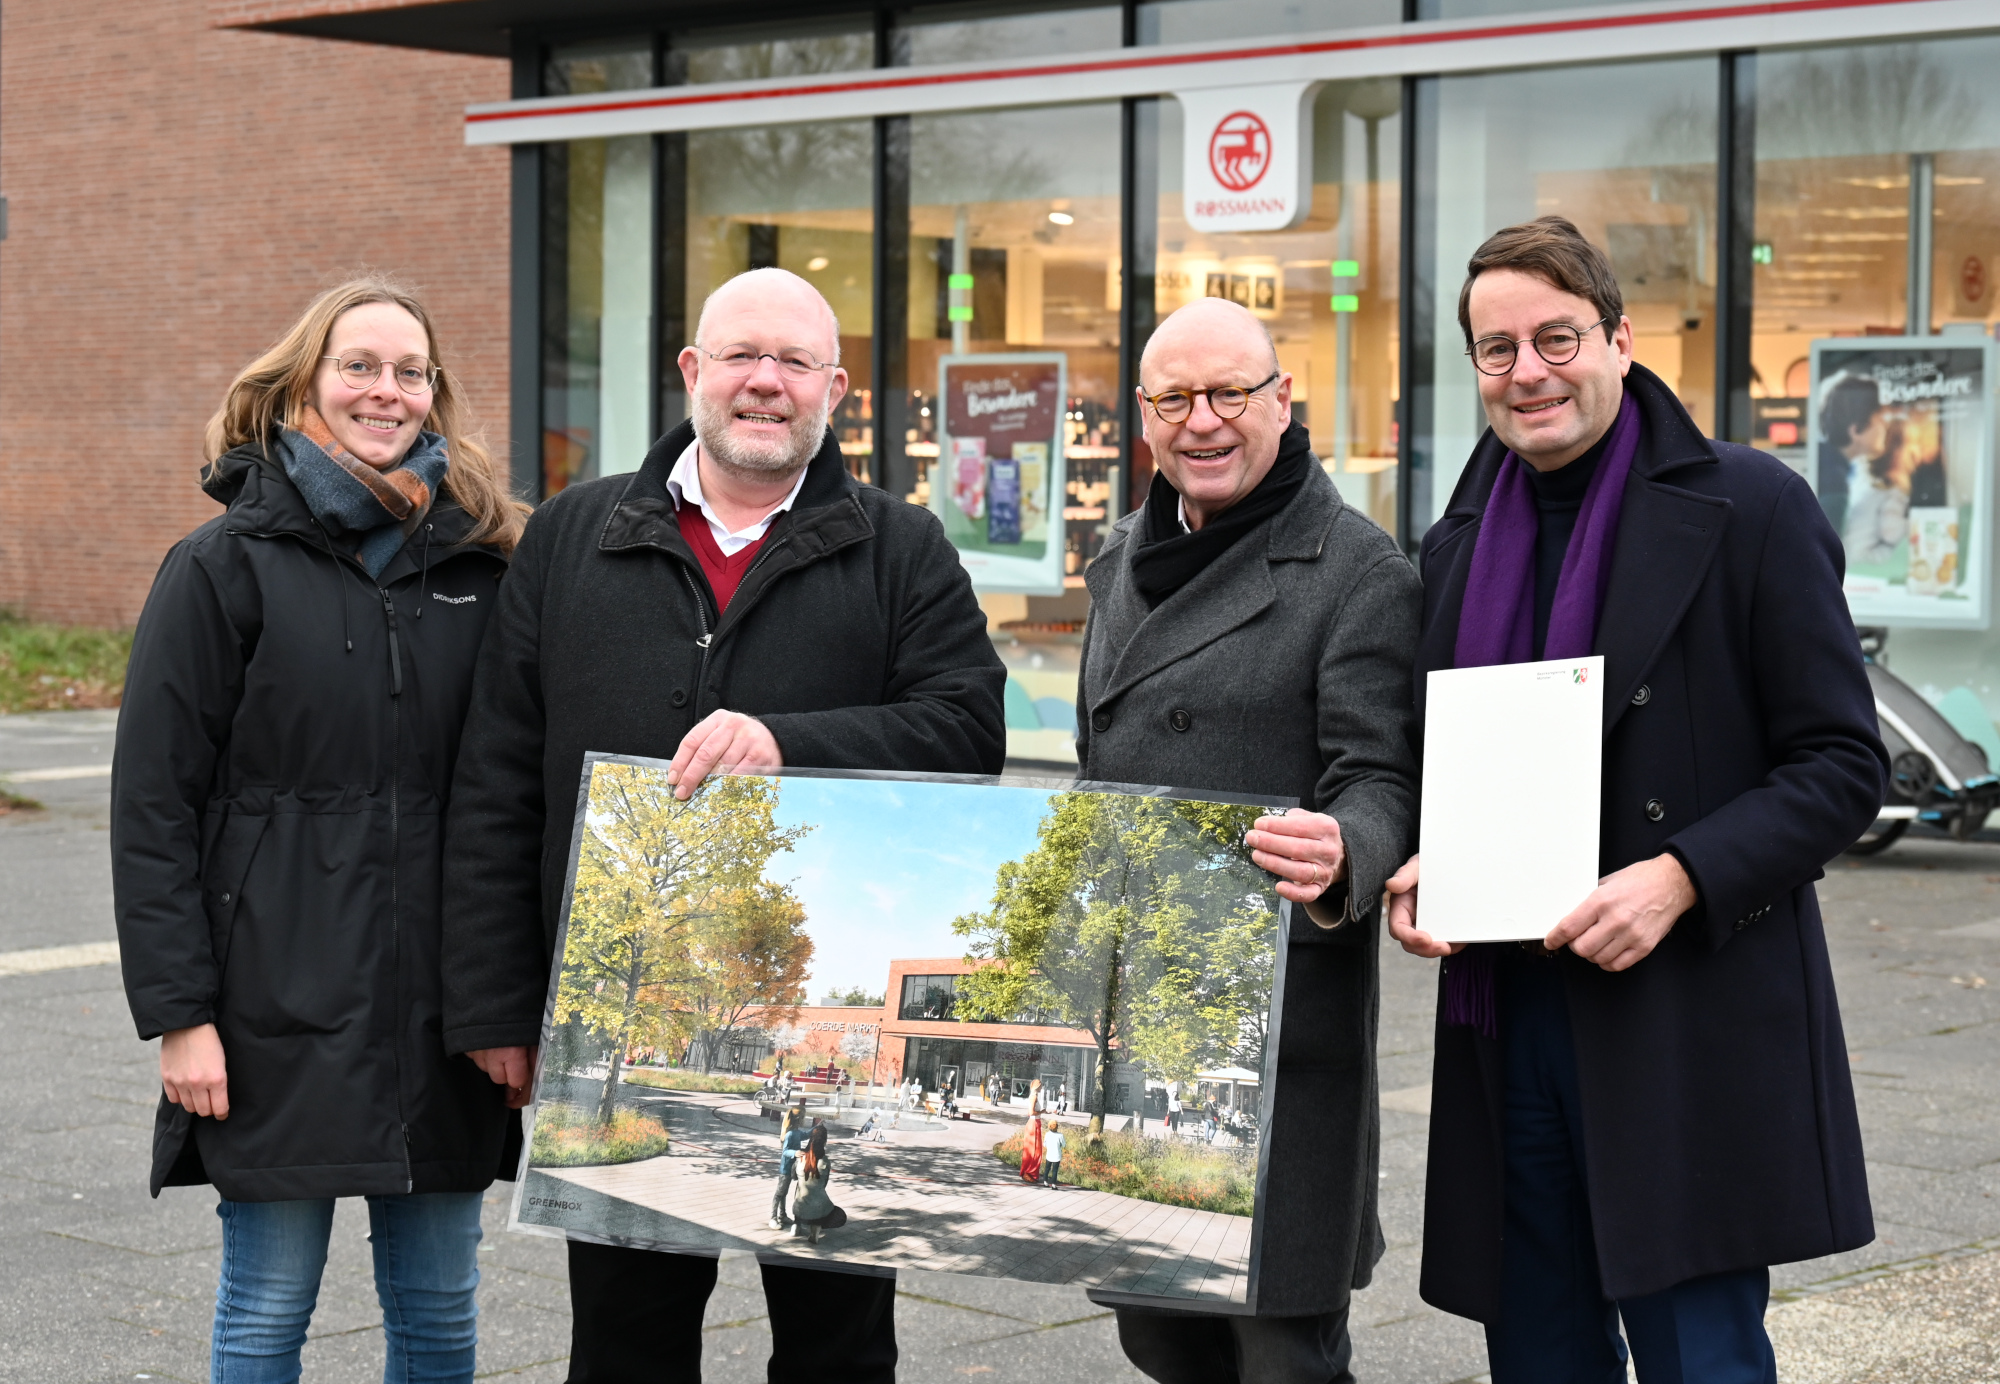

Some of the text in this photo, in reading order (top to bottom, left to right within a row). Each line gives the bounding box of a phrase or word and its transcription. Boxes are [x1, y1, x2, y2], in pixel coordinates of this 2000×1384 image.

[1194, 198, 1286, 218] ROSSMANN
[432, 592, 477, 605] DIDRIKSONS
[809, 1021, 846, 1034] COERDE
[528, 1196, 583, 1212] GREENBOX
